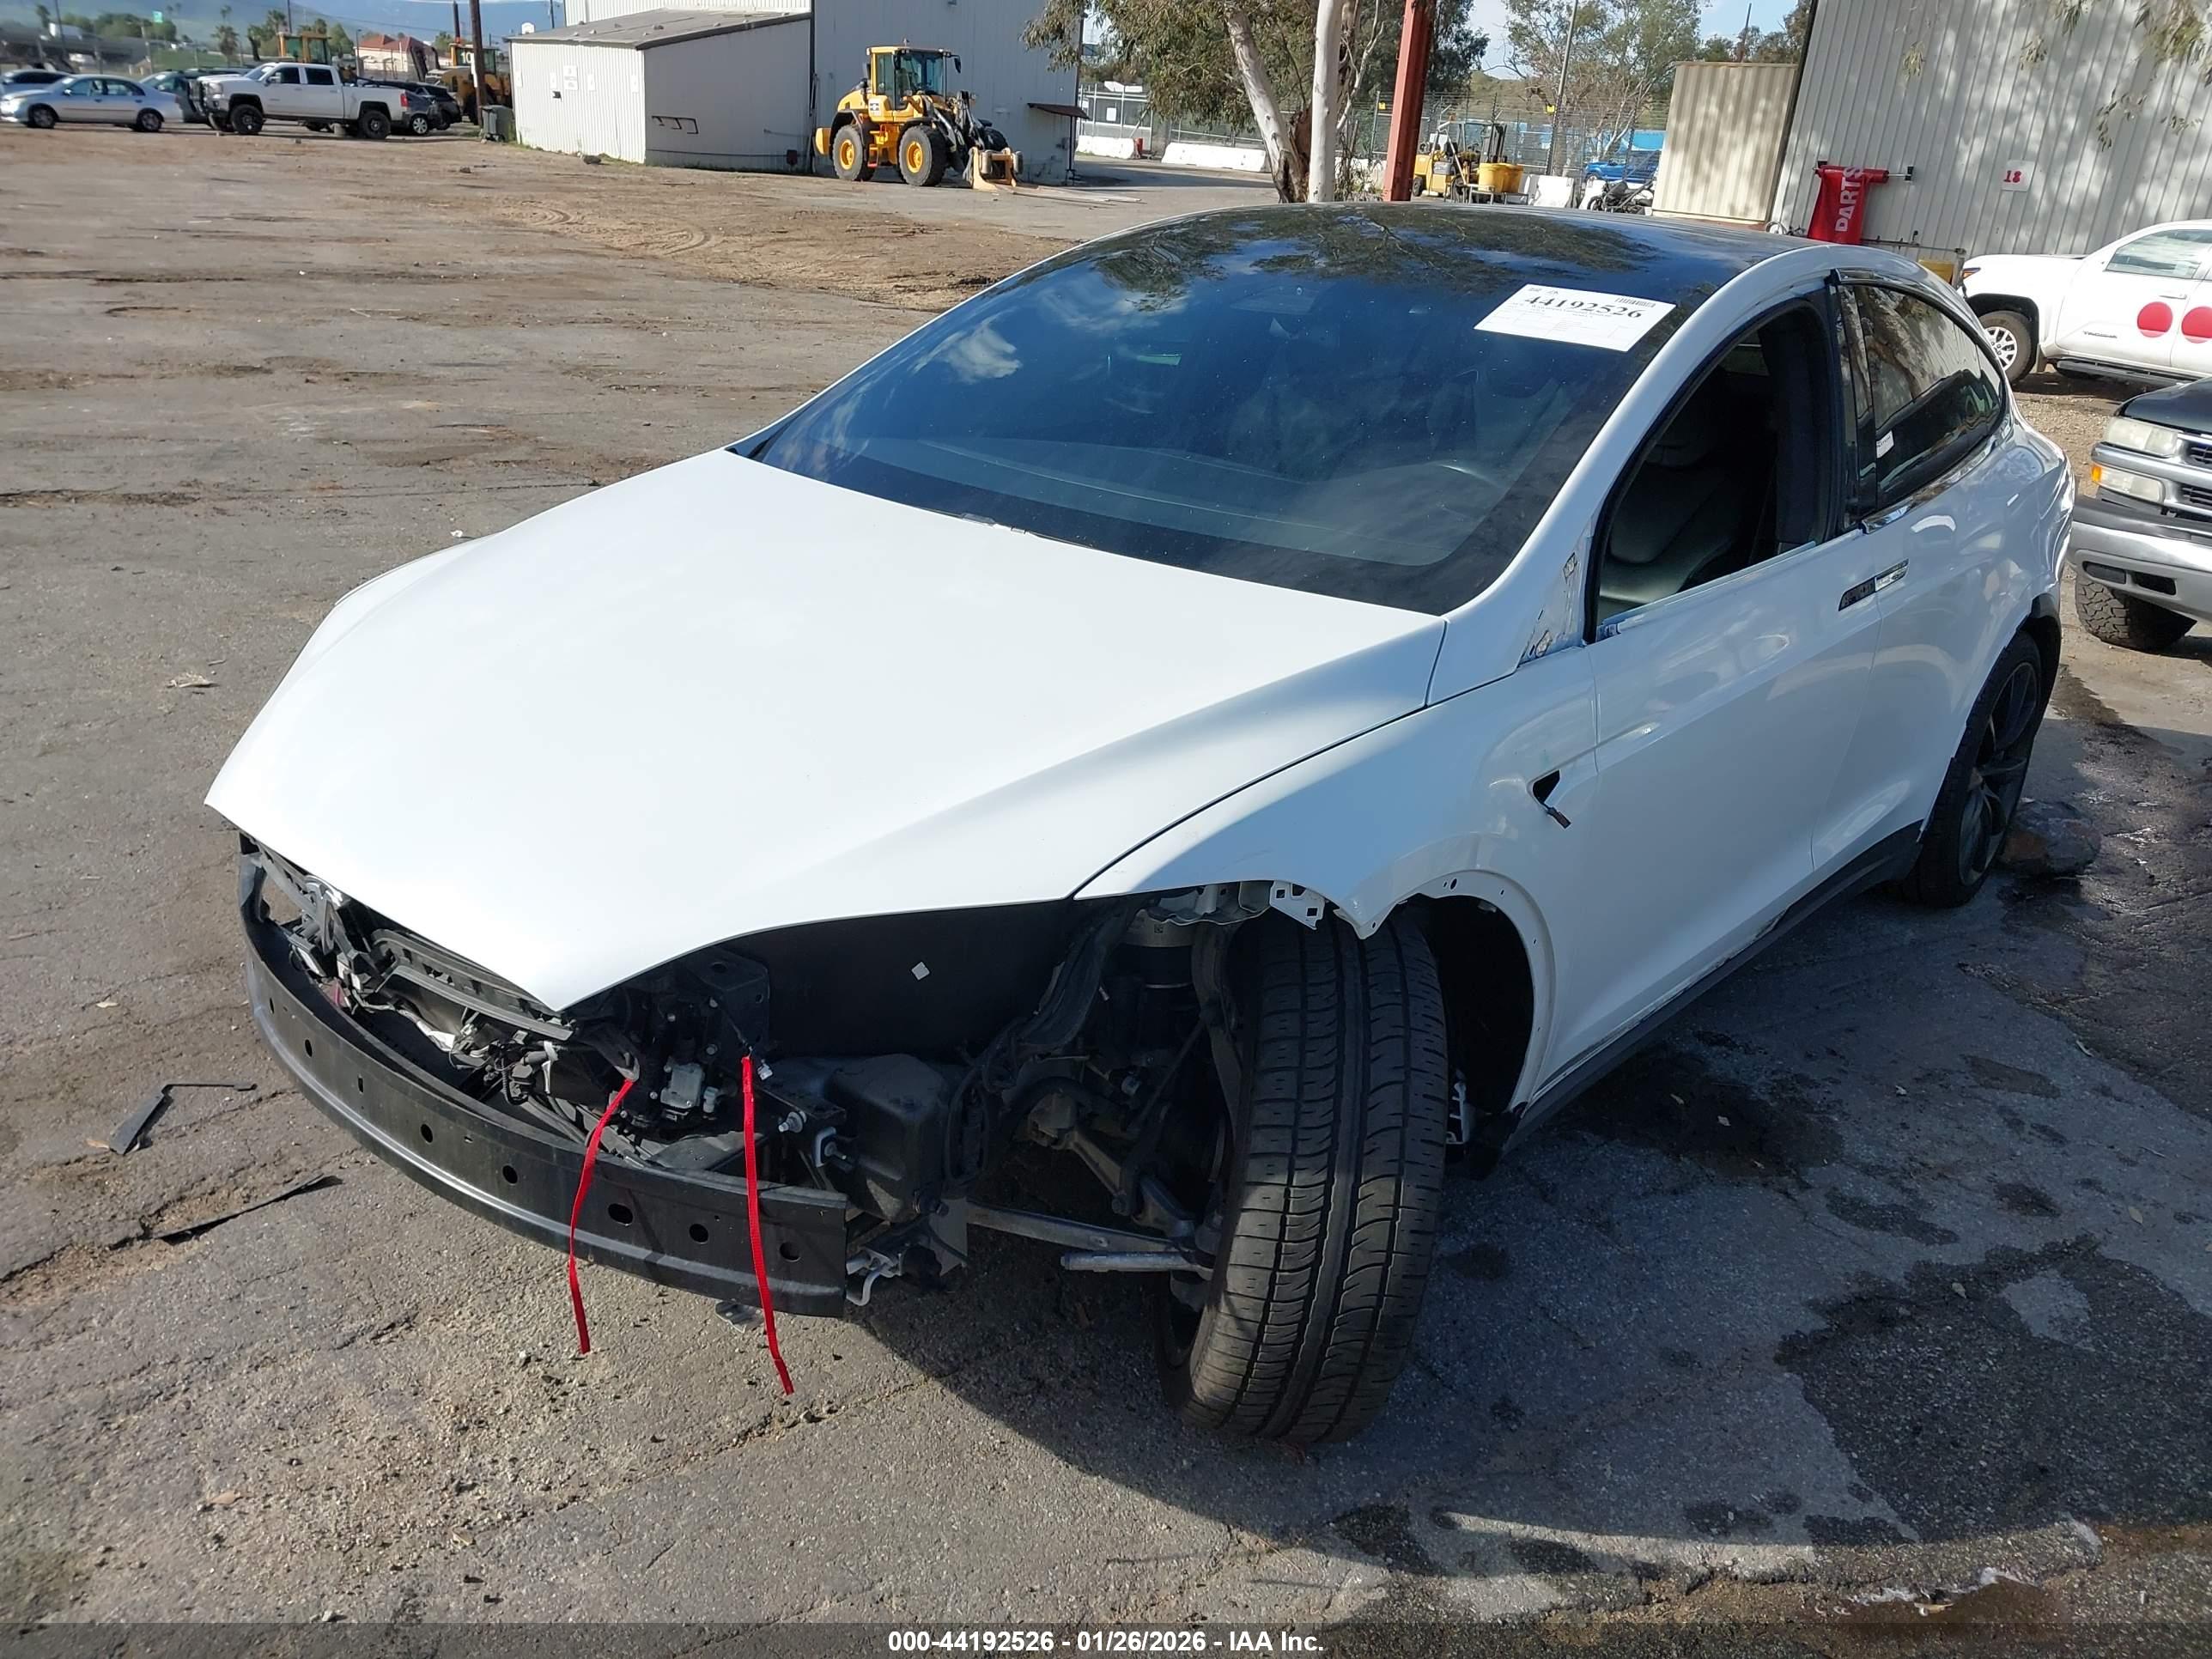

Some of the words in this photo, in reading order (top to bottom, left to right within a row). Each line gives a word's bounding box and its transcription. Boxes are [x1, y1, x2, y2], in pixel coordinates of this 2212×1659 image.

[2002, 170, 2021, 184] 18
[1834, 165, 1863, 232] PARTS
[1525, 296, 1646, 319] 44192526
